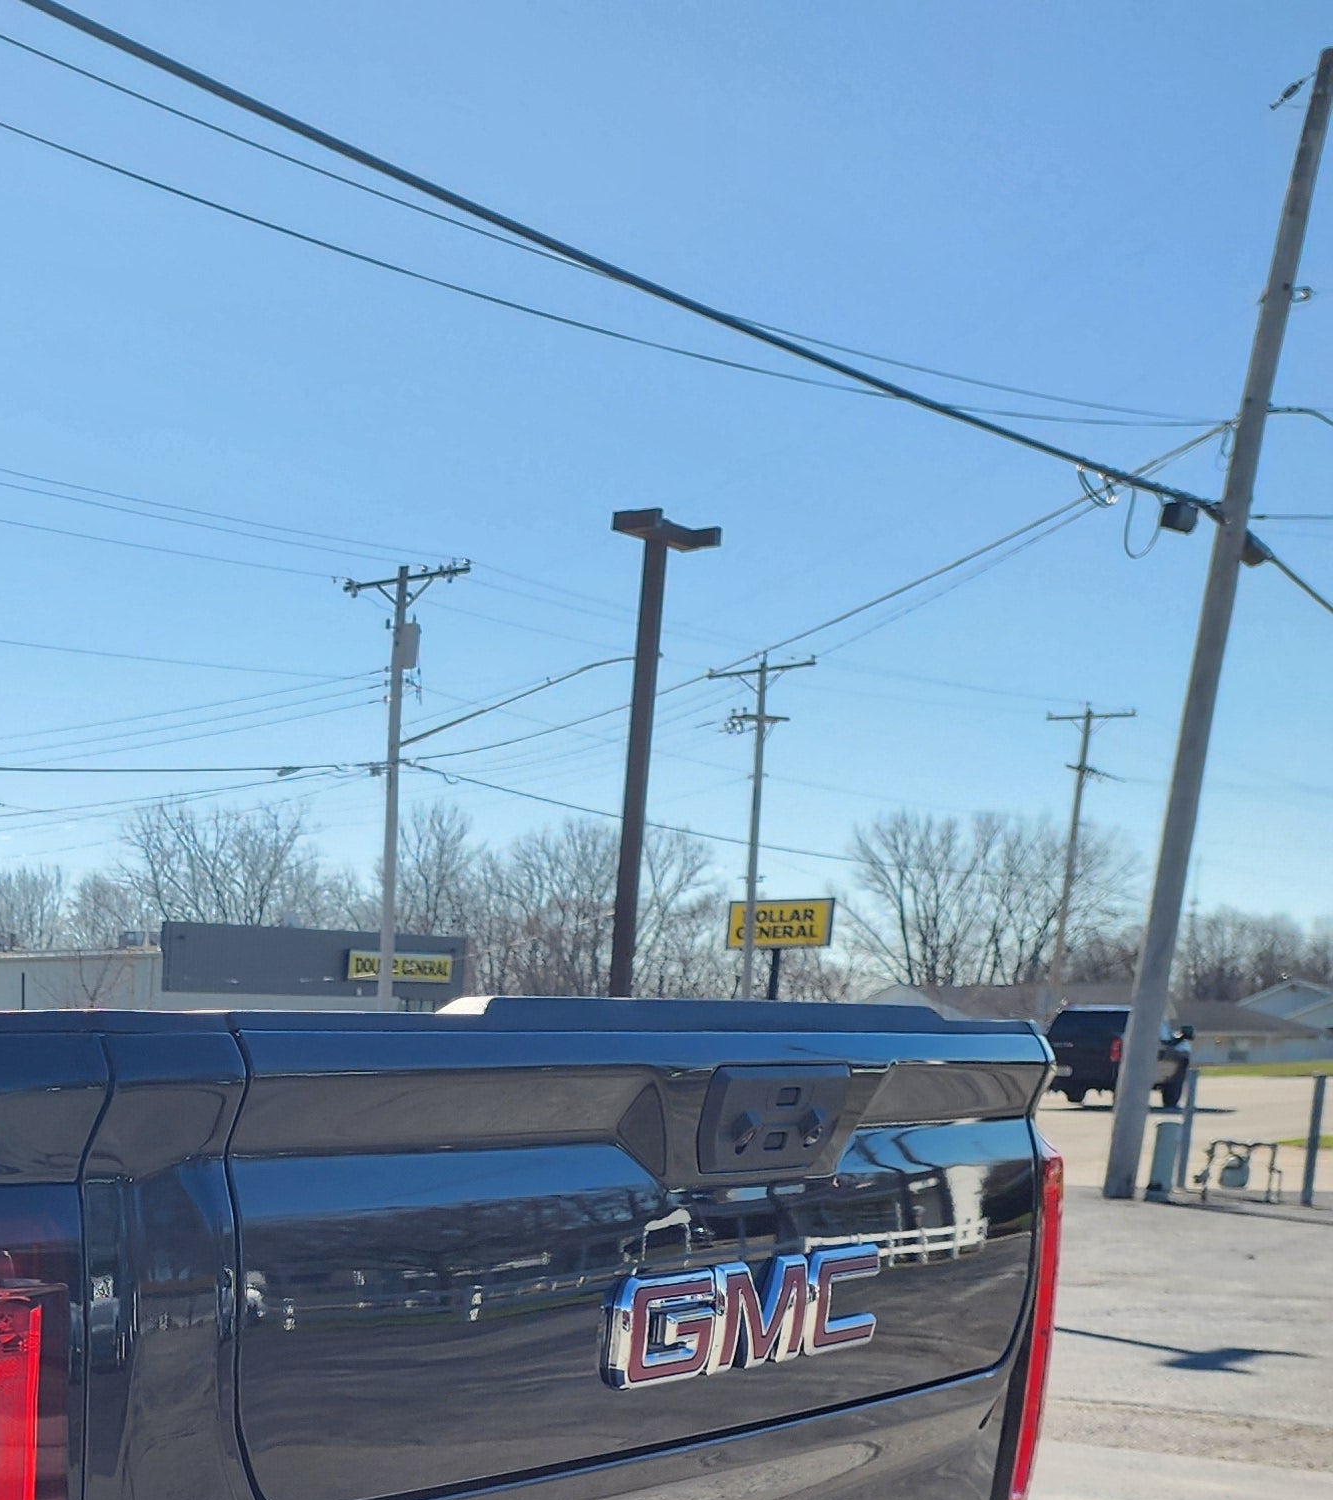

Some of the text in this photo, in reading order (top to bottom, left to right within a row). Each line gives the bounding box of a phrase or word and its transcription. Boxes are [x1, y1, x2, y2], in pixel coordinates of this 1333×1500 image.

[743, 908, 815, 923] OLLAR
[736, 925, 818, 940] GNERAL
[598, 1243, 880, 1390] GMC
